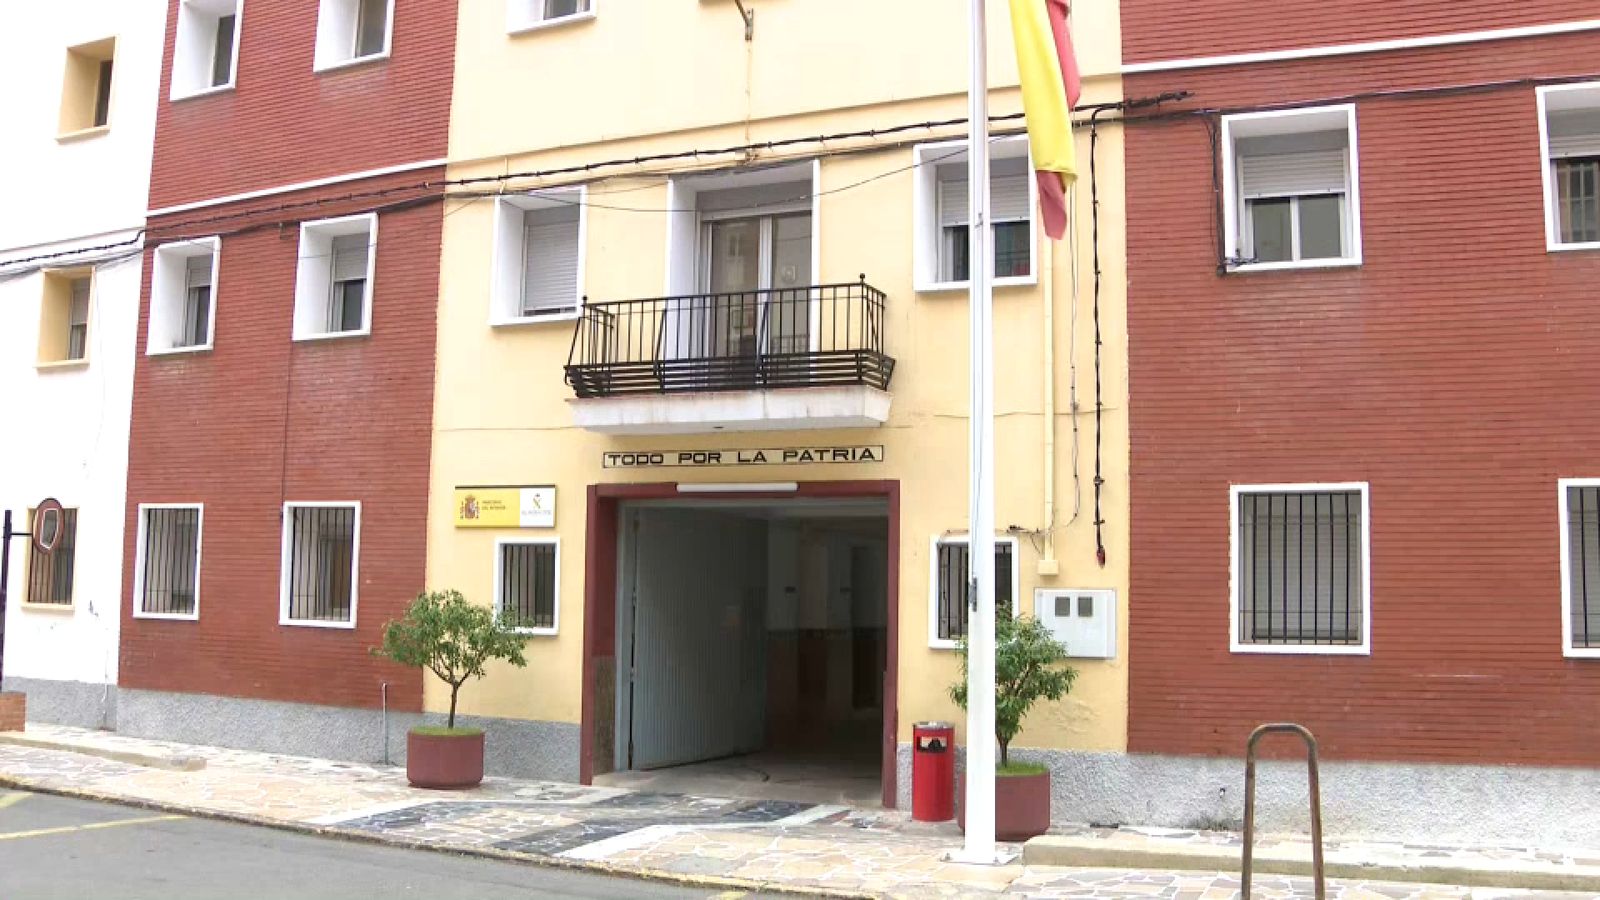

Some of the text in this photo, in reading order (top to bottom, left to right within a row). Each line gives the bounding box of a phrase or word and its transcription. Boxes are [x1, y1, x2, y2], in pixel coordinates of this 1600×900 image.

[608, 448, 875, 465] TODO POR LA PATRIA
